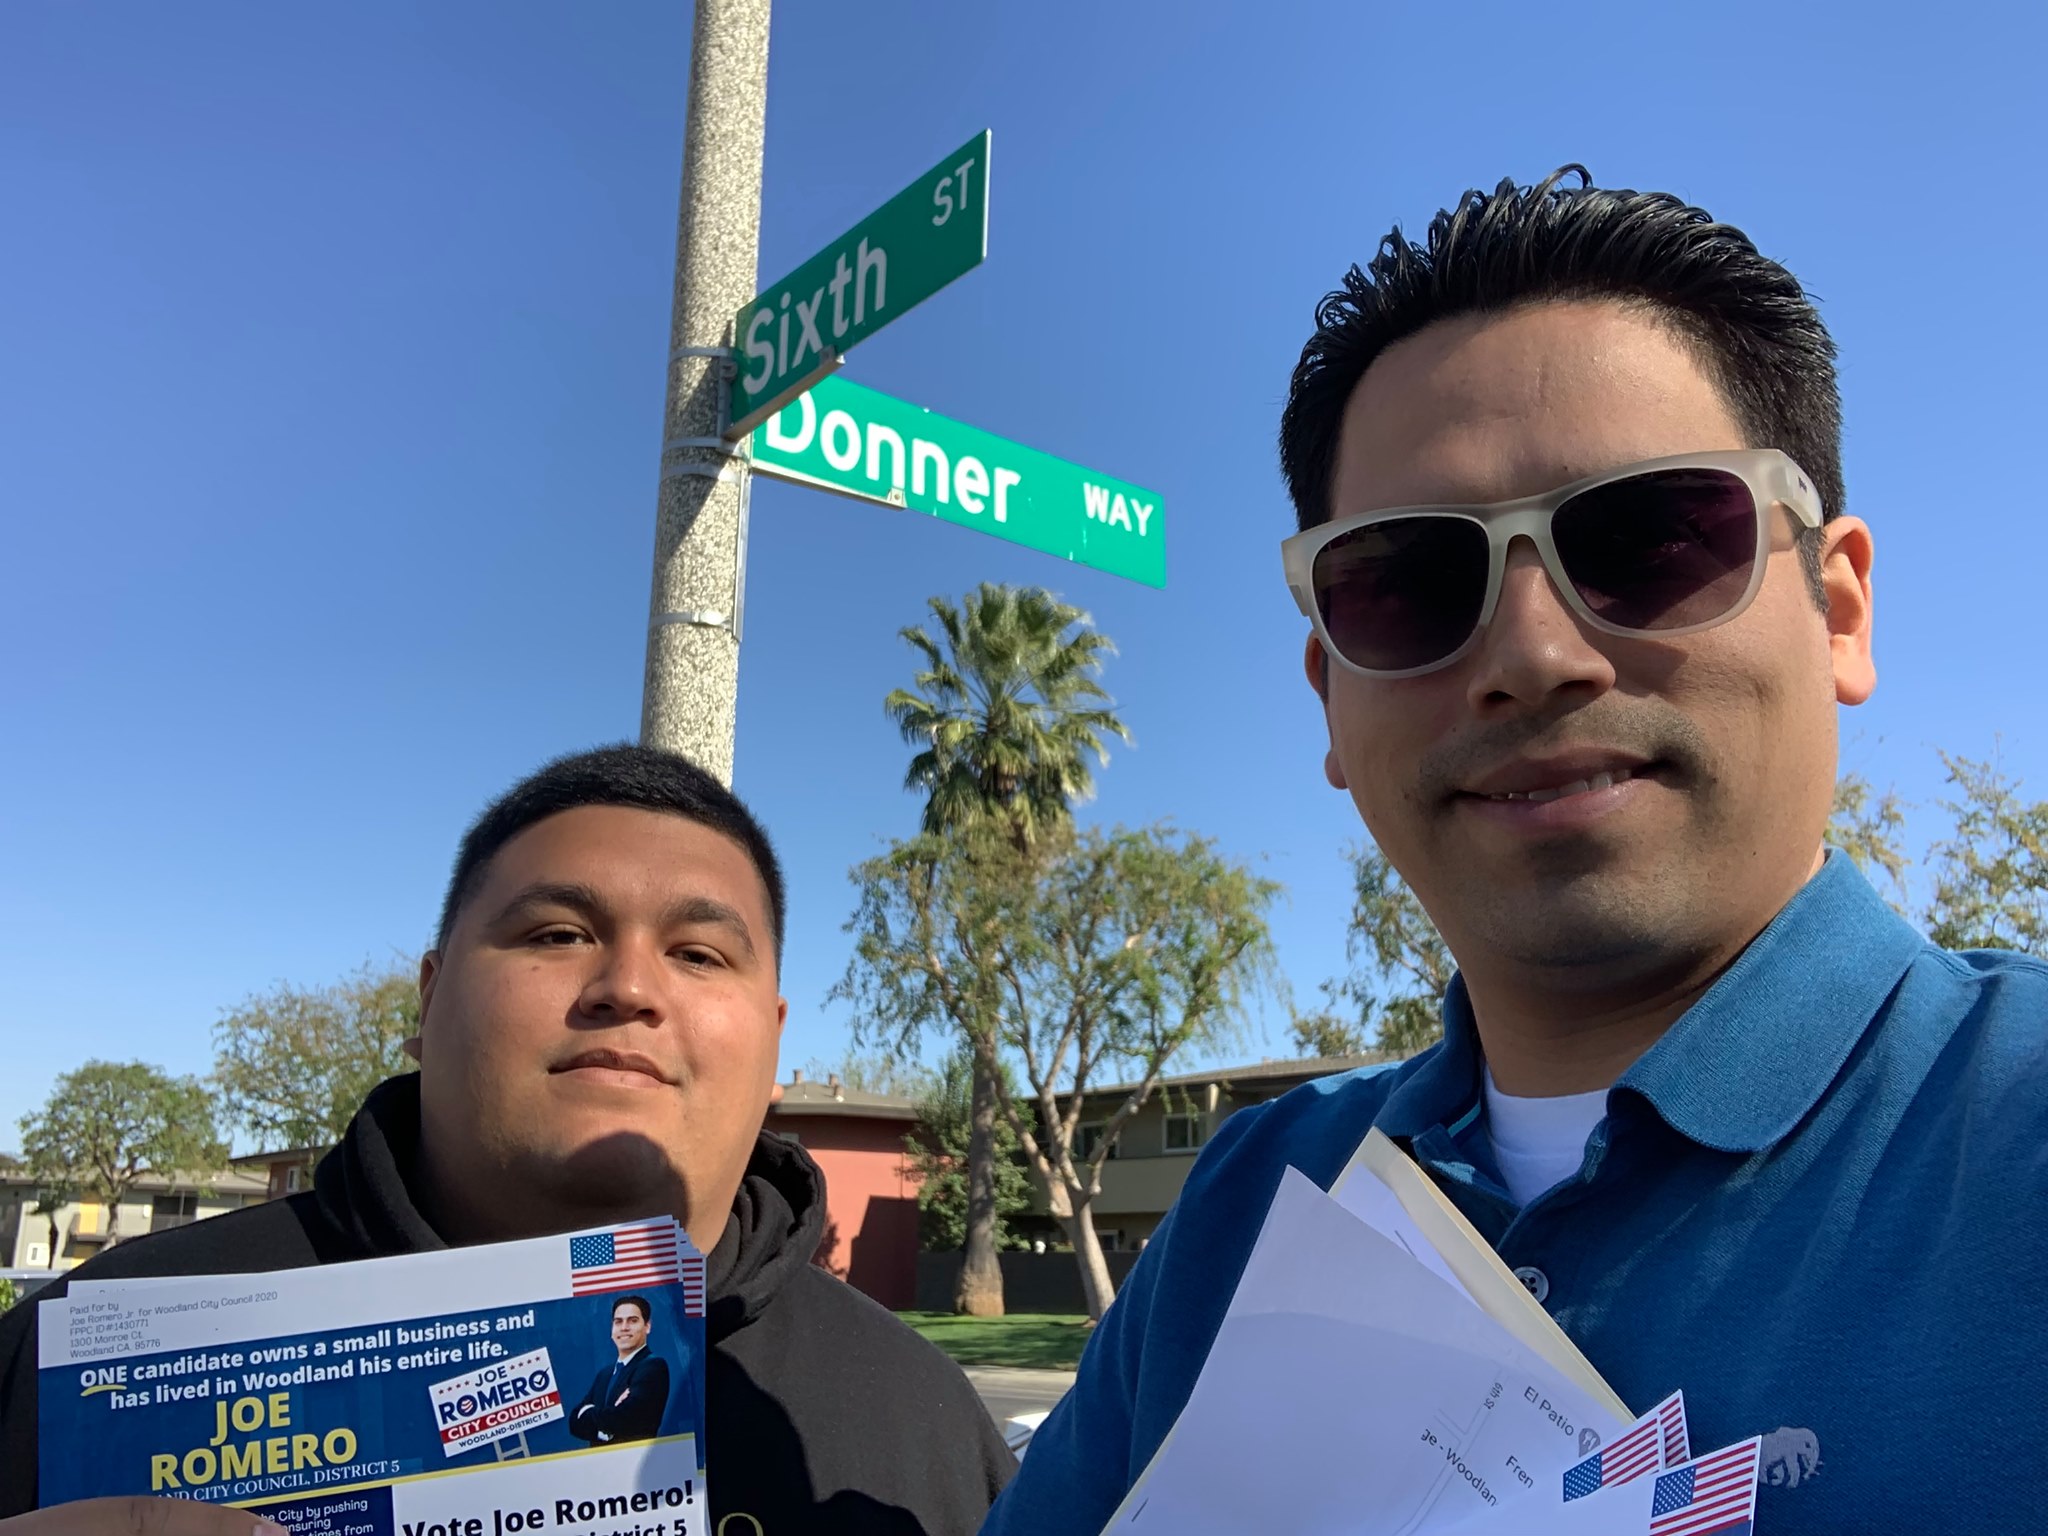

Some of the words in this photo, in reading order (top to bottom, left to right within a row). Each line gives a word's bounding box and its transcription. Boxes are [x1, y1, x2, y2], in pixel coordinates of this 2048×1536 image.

[742, 236, 888, 395] Sixth
[932, 158, 975, 227] ST
[764, 389, 1021, 524] Donner
[1083, 482, 1154, 538] WAY
[70, 1305, 89, 1315] Paid
[92, 1303, 105, 1312] for
[108, 1302, 119, 1311] by
[70, 1317, 85, 1326] Joe
[88, 1313, 122, 1323] Romero
[139, 1308, 152, 1317] for
[154, 1301, 199, 1315] Woodland
[200, 1300, 219, 1309] City
[221, 1294, 253, 1306] Council
[255, 1291, 278, 1302] 2020
[70, 1325, 93, 1336] FPPC
[70, 1336, 92, 1348] 1300
[95, 1333, 128, 1344] Monroe
[70, 1345, 115, 1358] Woodland
[81, 1365, 128, 1388] ONE
[133, 1353, 244, 1380] candidate
[250, 1344, 308, 1365] owns
[313, 1342, 327, 1357] a
[332, 1328, 391, 1354] small
[397, 1321, 490, 1346] business
[495, 1309, 535, 1331] and
[111, 1391, 150, 1410] has
[156, 1379, 210, 1403] lived
[216, 1376, 237, 1395] in
[242, 1359, 354, 1392] Woodland
[360, 1355, 392, 1376] his
[397, 1347, 463, 1370] entire
[468, 1340, 509, 1361] life.
[438, 1367, 550, 1425] ROMERO
[475, 1365, 507, 1387] JOE
[210, 1392, 291, 1446] JOE
[447, 1419, 481, 1440] CITY
[485, 1395, 555, 1427] COUNCIL
[1524, 1386, 1539, 1404] El
[1539, 1399, 1575, 1437] Patio
[151, 1427, 357, 1491] ROMERO
[193, 1483, 231, 1501] CITY
[234, 1473, 311, 1496] COUNCIL,
[314, 1460, 388, 1484] DISTRICT
[391, 1459, 400, 1473] 5
[1505, 1455, 1534, 1489] Fren
[278, 1509, 303, 1521] City
[306, 1506, 321, 1519] by
[323, 1499, 368, 1517] pushing
[402, 1518, 483, 1536] Vote
[493, 1509, 545, 1536] Joe
[555, 1480, 694, 1526] Romero!
[674, 1519, 687, 1536] 5
[344, 1523, 374, 1536] from
